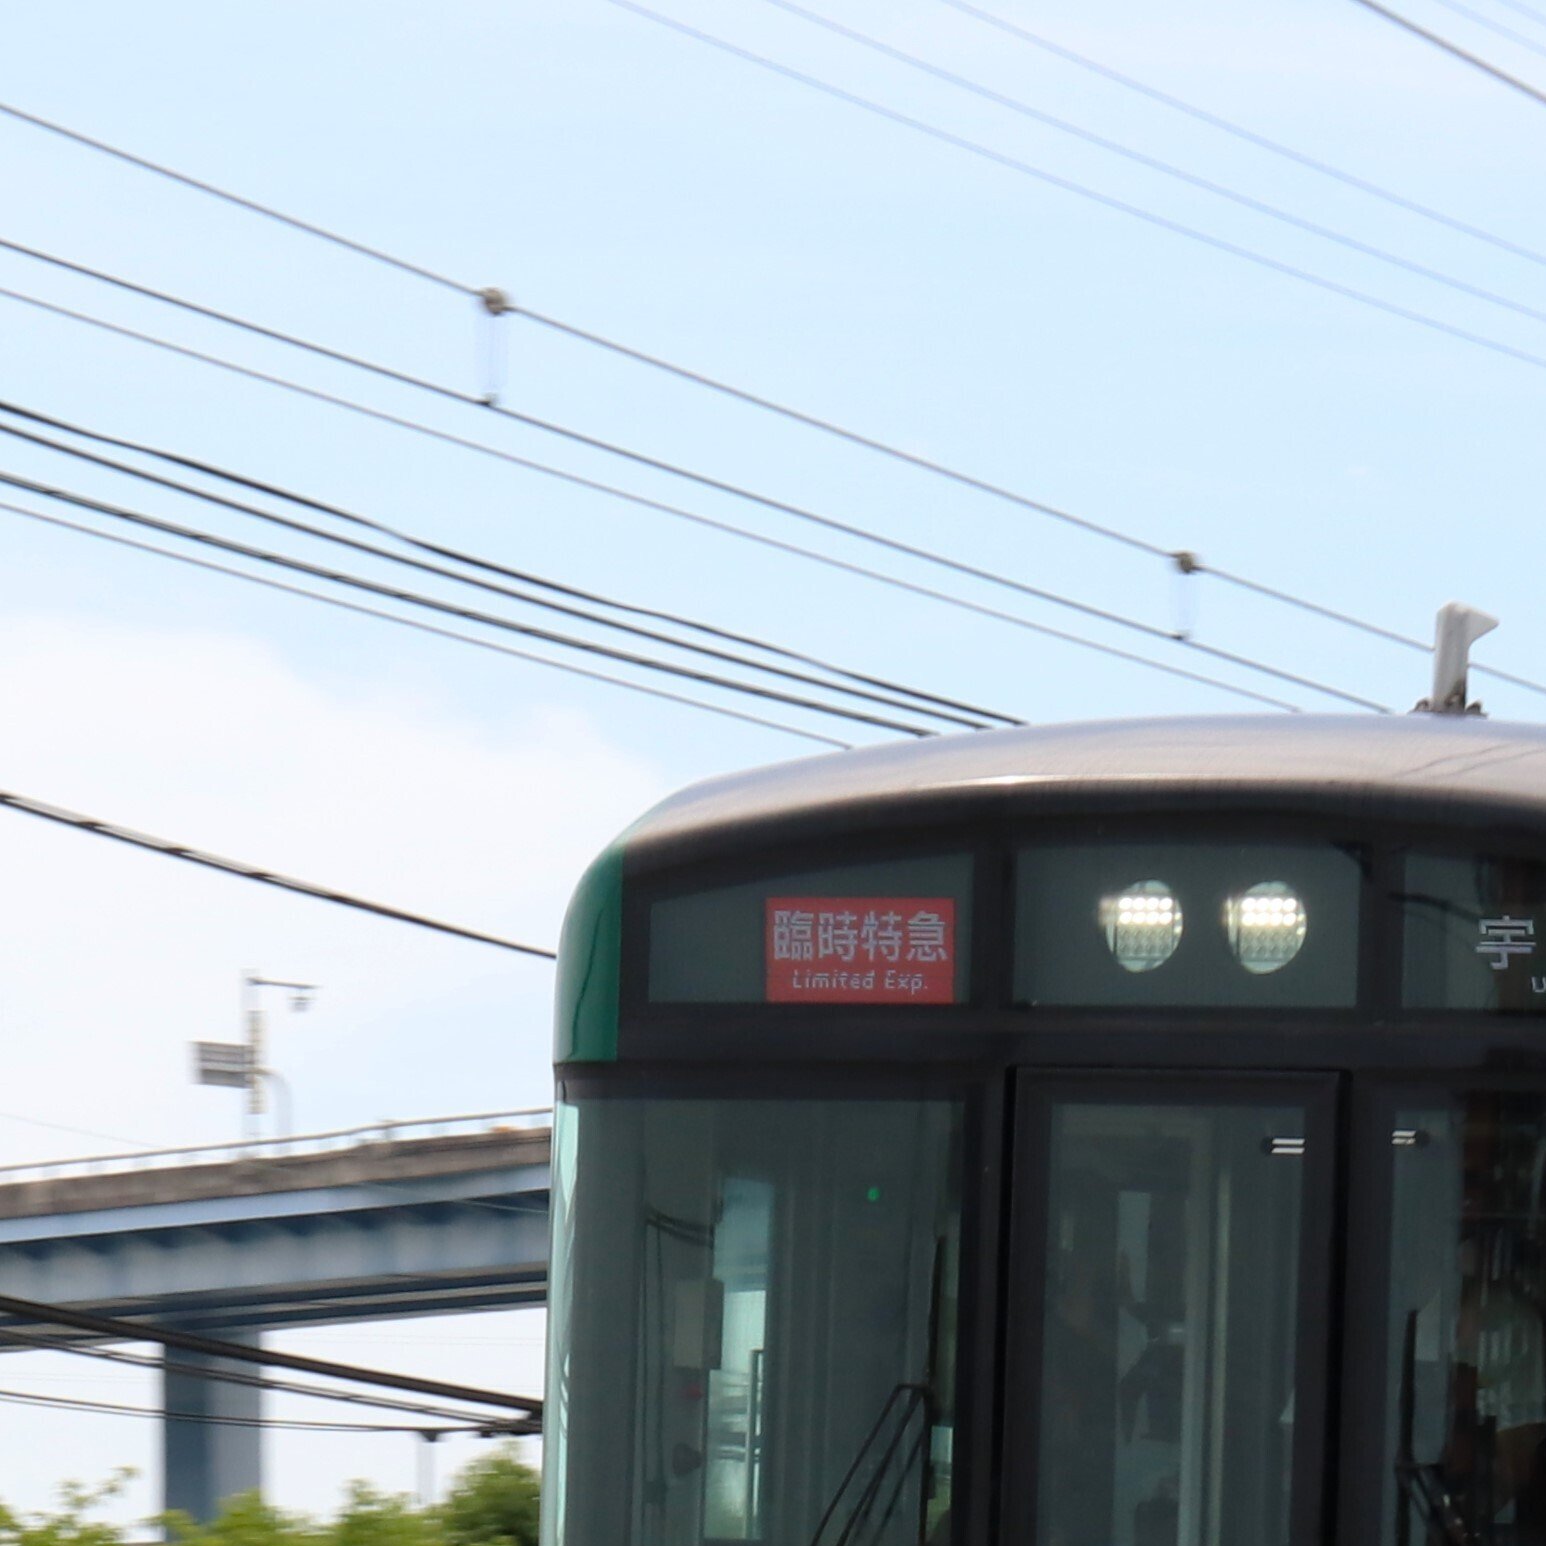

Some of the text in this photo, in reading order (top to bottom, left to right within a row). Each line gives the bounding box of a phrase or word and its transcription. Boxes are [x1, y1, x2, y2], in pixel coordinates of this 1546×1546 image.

[773, 909, 948, 963] 臨時特急
[791, 969, 928, 995] Limited Exp.
